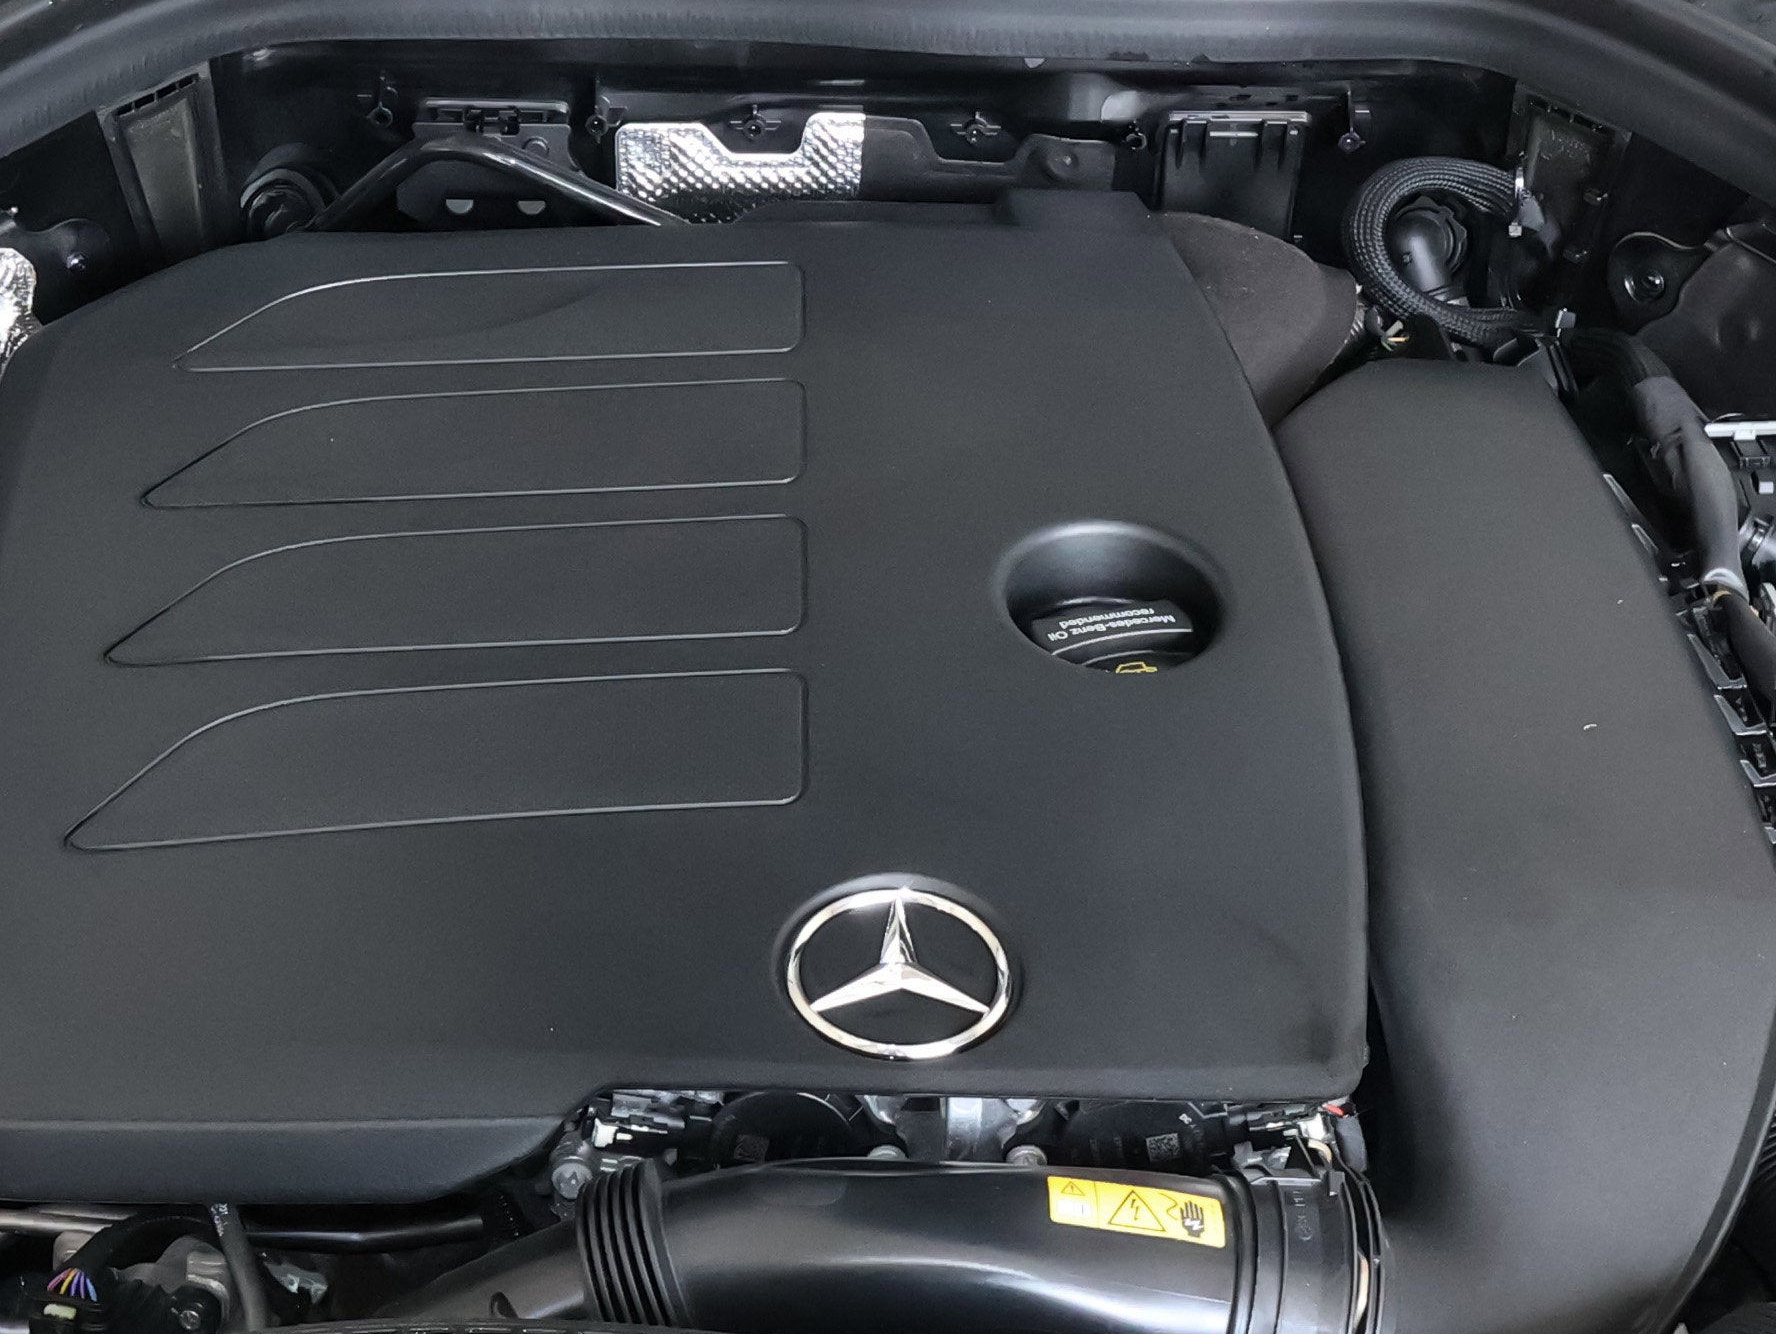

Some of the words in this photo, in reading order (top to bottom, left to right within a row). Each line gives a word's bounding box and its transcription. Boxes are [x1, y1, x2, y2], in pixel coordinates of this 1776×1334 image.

[1060, 609, 1155, 629] recommended
[1071, 615, 1175, 635] Mercedes-Benz
[1048, 631, 1068, 641] Oil
